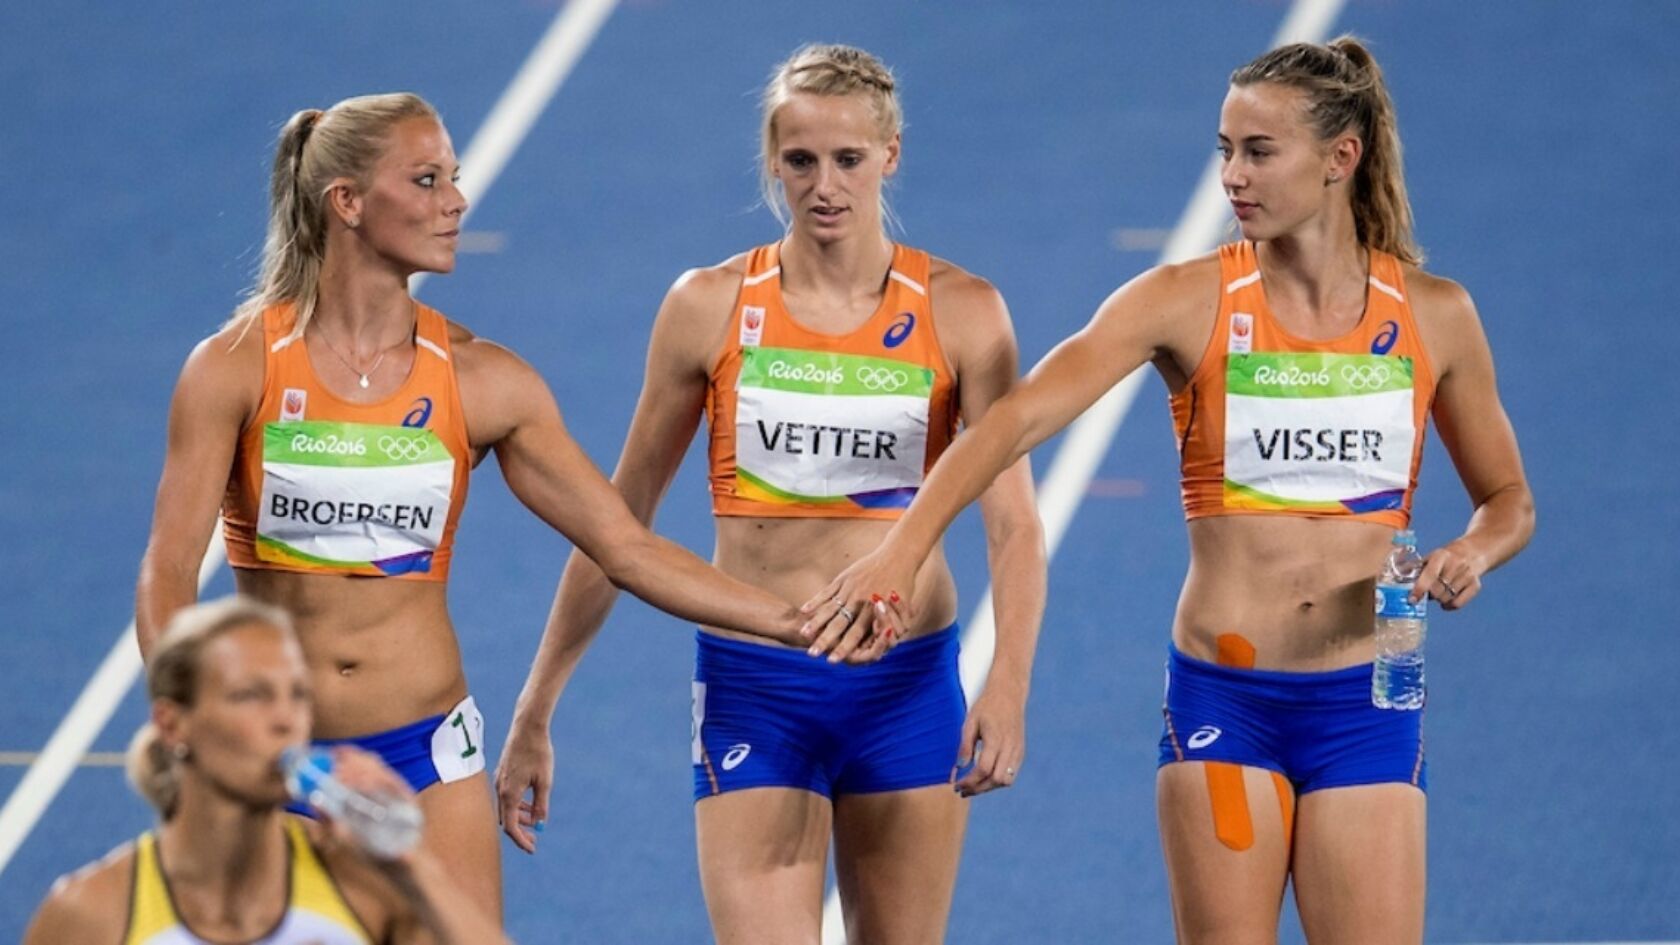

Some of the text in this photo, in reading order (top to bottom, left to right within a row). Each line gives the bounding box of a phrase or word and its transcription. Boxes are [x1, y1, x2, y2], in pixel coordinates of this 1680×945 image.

[769, 360, 844, 384] Rio2016
[1254, 365, 1330, 386] Rio2016
[291, 433, 366, 455] Rio2016
[757, 419, 898, 460] VETTER
[1252, 428, 1384, 462] VISSER
[270, 493, 433, 530] BROERSEN
